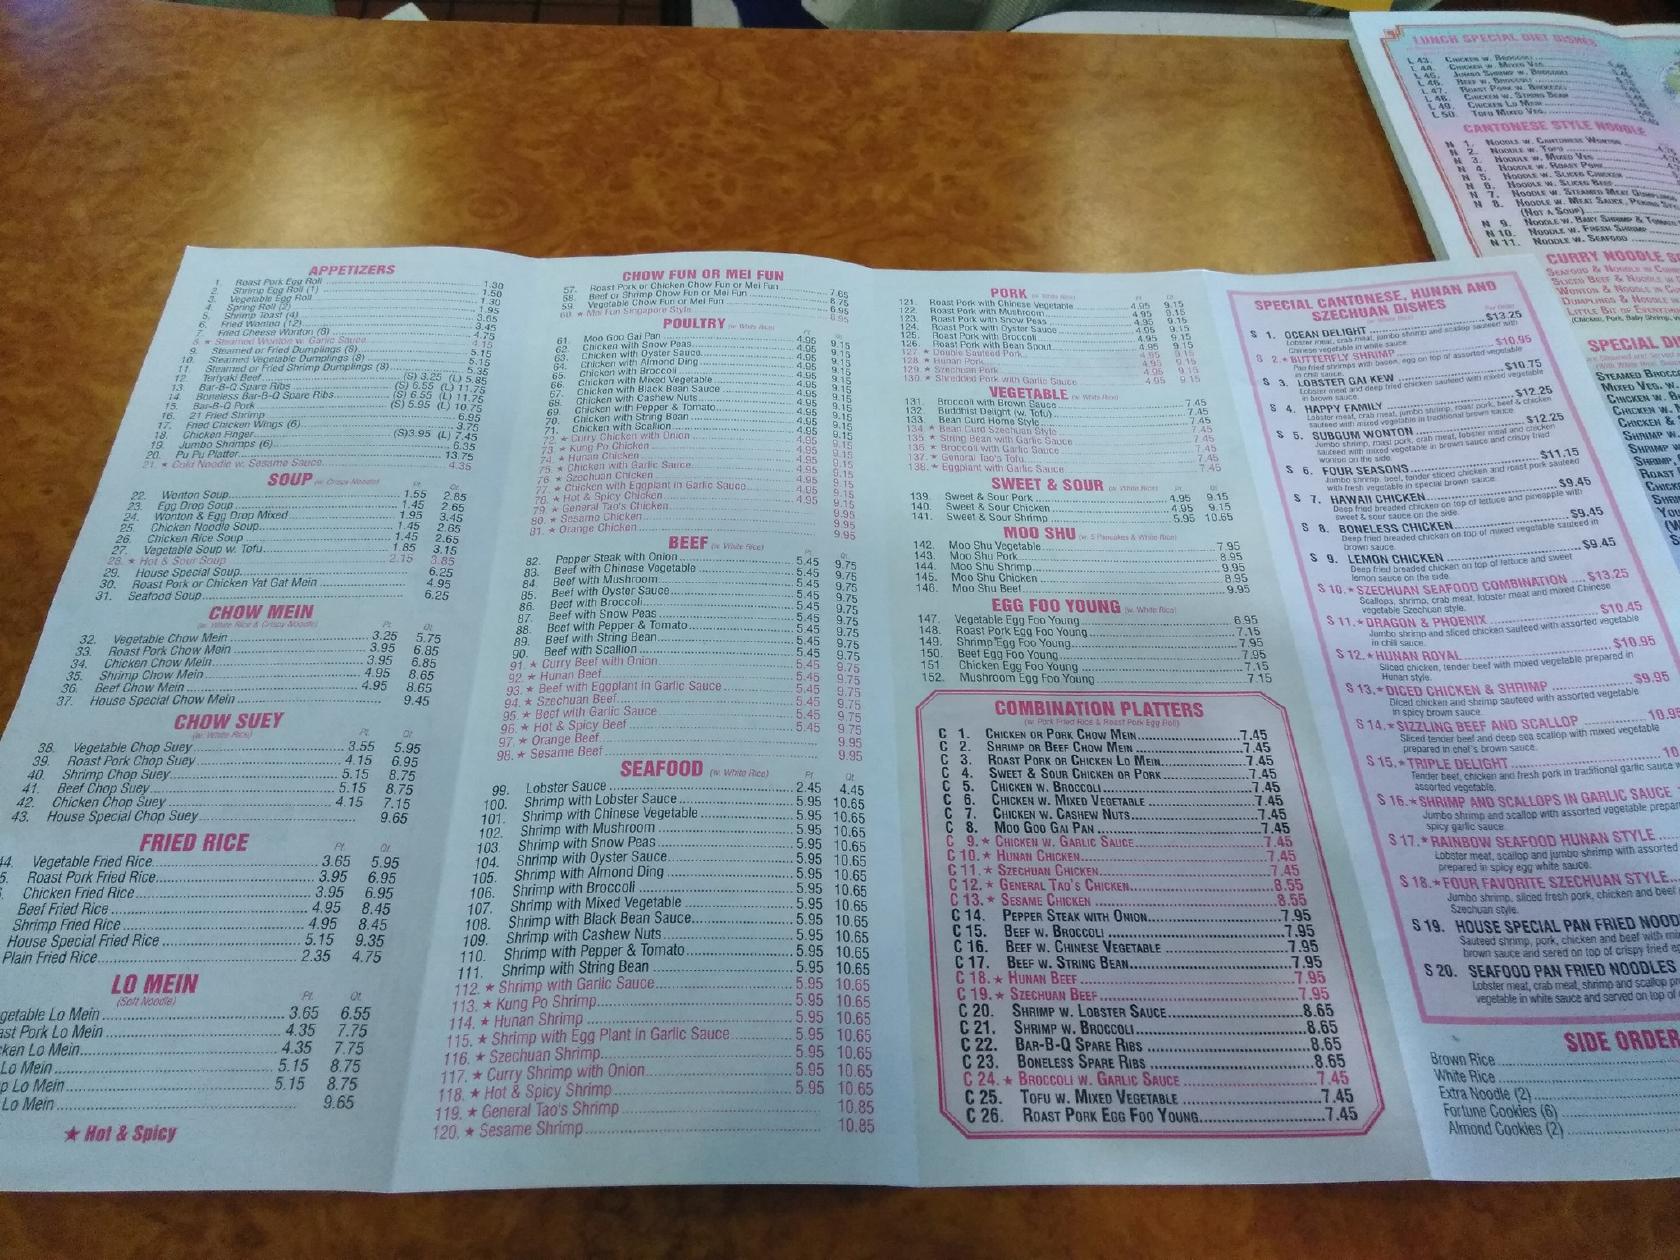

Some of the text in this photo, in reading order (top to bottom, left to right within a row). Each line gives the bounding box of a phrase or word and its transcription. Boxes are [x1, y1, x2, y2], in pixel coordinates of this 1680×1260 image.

[1463, 121, 1646, 136] CANTONESE STYLE NOODLE
[1545, 251, 1665, 264] CURRY NOODLE
[309, 265, 396, 276] APPETIZERS
[622, 270, 784, 281] CHOW FUN OR MEI FUN
[990, 288, 1028, 299] PORK
[1255, 281, 1498, 311] SPECIAL CANTONESE, HUNAN AND
[1312, 305, 1389, 321] SZECHUAN
[1393, 299, 1446, 314] DISHES
[663, 318, 726, 329] POULTRY
[1587, 337, 1657, 352] SPECIAL
[989, 386, 1069, 400] VEGETABLE
[267, 473, 313, 486] SOUP
[991, 478, 1104, 491] SWEET & SOUR
[1302, 507, 1604, 534] S 8. BONELESS CHICKEN $9.45
[1003, 526, 1076, 540] MOO SHU
[668, 536, 709, 551] BEEF
[209, 604, 314, 620] CHOW MEIN
[992, 599, 1121, 614] EGG FOO YOUNG
[512, 644, 860, 662] 90. Beef with Scallion 5.45 9.75
[922, 672, 1272, 686] 152. Mushroom Egg Foo Young 7.15
[995, 701, 1204, 718] COMBINATION PLATTERS
[174, 712, 284, 730] CHOW SUEY
[939, 728, 1268, 741] C 1. CHICKEN OR PORK CHOW MEIN 7.45
[620, 761, 704, 777] SEAFOOD
[11, 810, 408, 824] 43. House Special Chop Suey 9.65
[139, 833, 249, 851] FRIED RICE
[1389, 829, 1656, 848] S 17. RAINBOW SEAFOOD HUNAN STYLE
[18, 901, 390, 916] Beef Fried Rice 4.95 8.45
[463, 928, 869, 947] 109. Shrimp with Cashew Nuts 5.95 10.65
[1424, 960, 1676, 978] S 20. SEAFOOD PAN FRIED NOODLES
[112, 973, 199, 995] LO MEIN
[1564, 1032, 1611, 1053] SIDE
[1431, 1052, 1496, 1066] Brown Rice
[966, 1106, 1359, 1123] C 26. ROAST PORK EGG FOO YOUNG 7.45
[85, 1125, 177, 1143] Hot & Spicy
[433, 1119, 874, 1140] 120. Sesame Shrimp 10.85
[1449, 1121, 1564, 1139] Almond Cookies (2)
